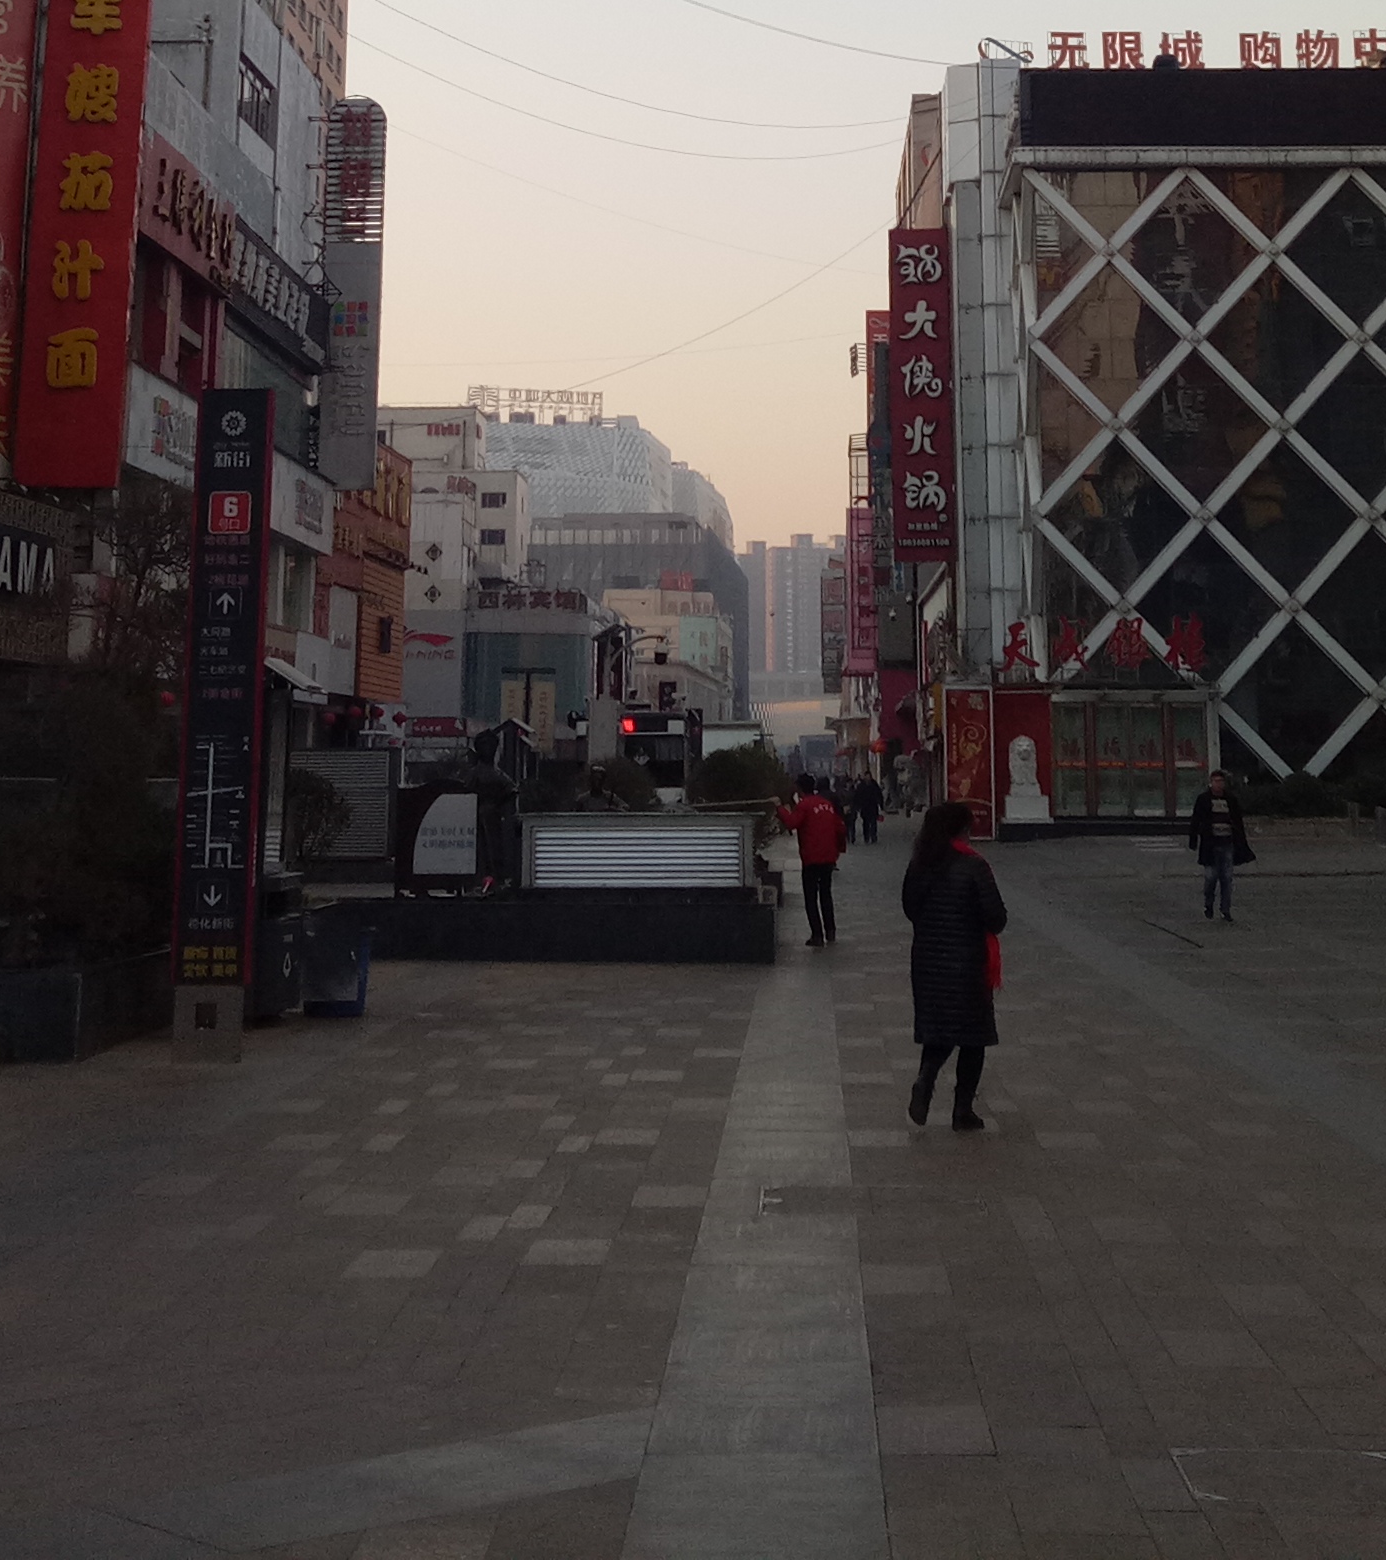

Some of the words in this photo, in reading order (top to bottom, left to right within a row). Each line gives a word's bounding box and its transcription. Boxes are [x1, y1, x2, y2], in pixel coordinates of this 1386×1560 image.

[1048, 30, 1205, 71] 无限城
[895, 244, 947, 512] 锅大侠火锅
[223, 497, 239, 517] 6
